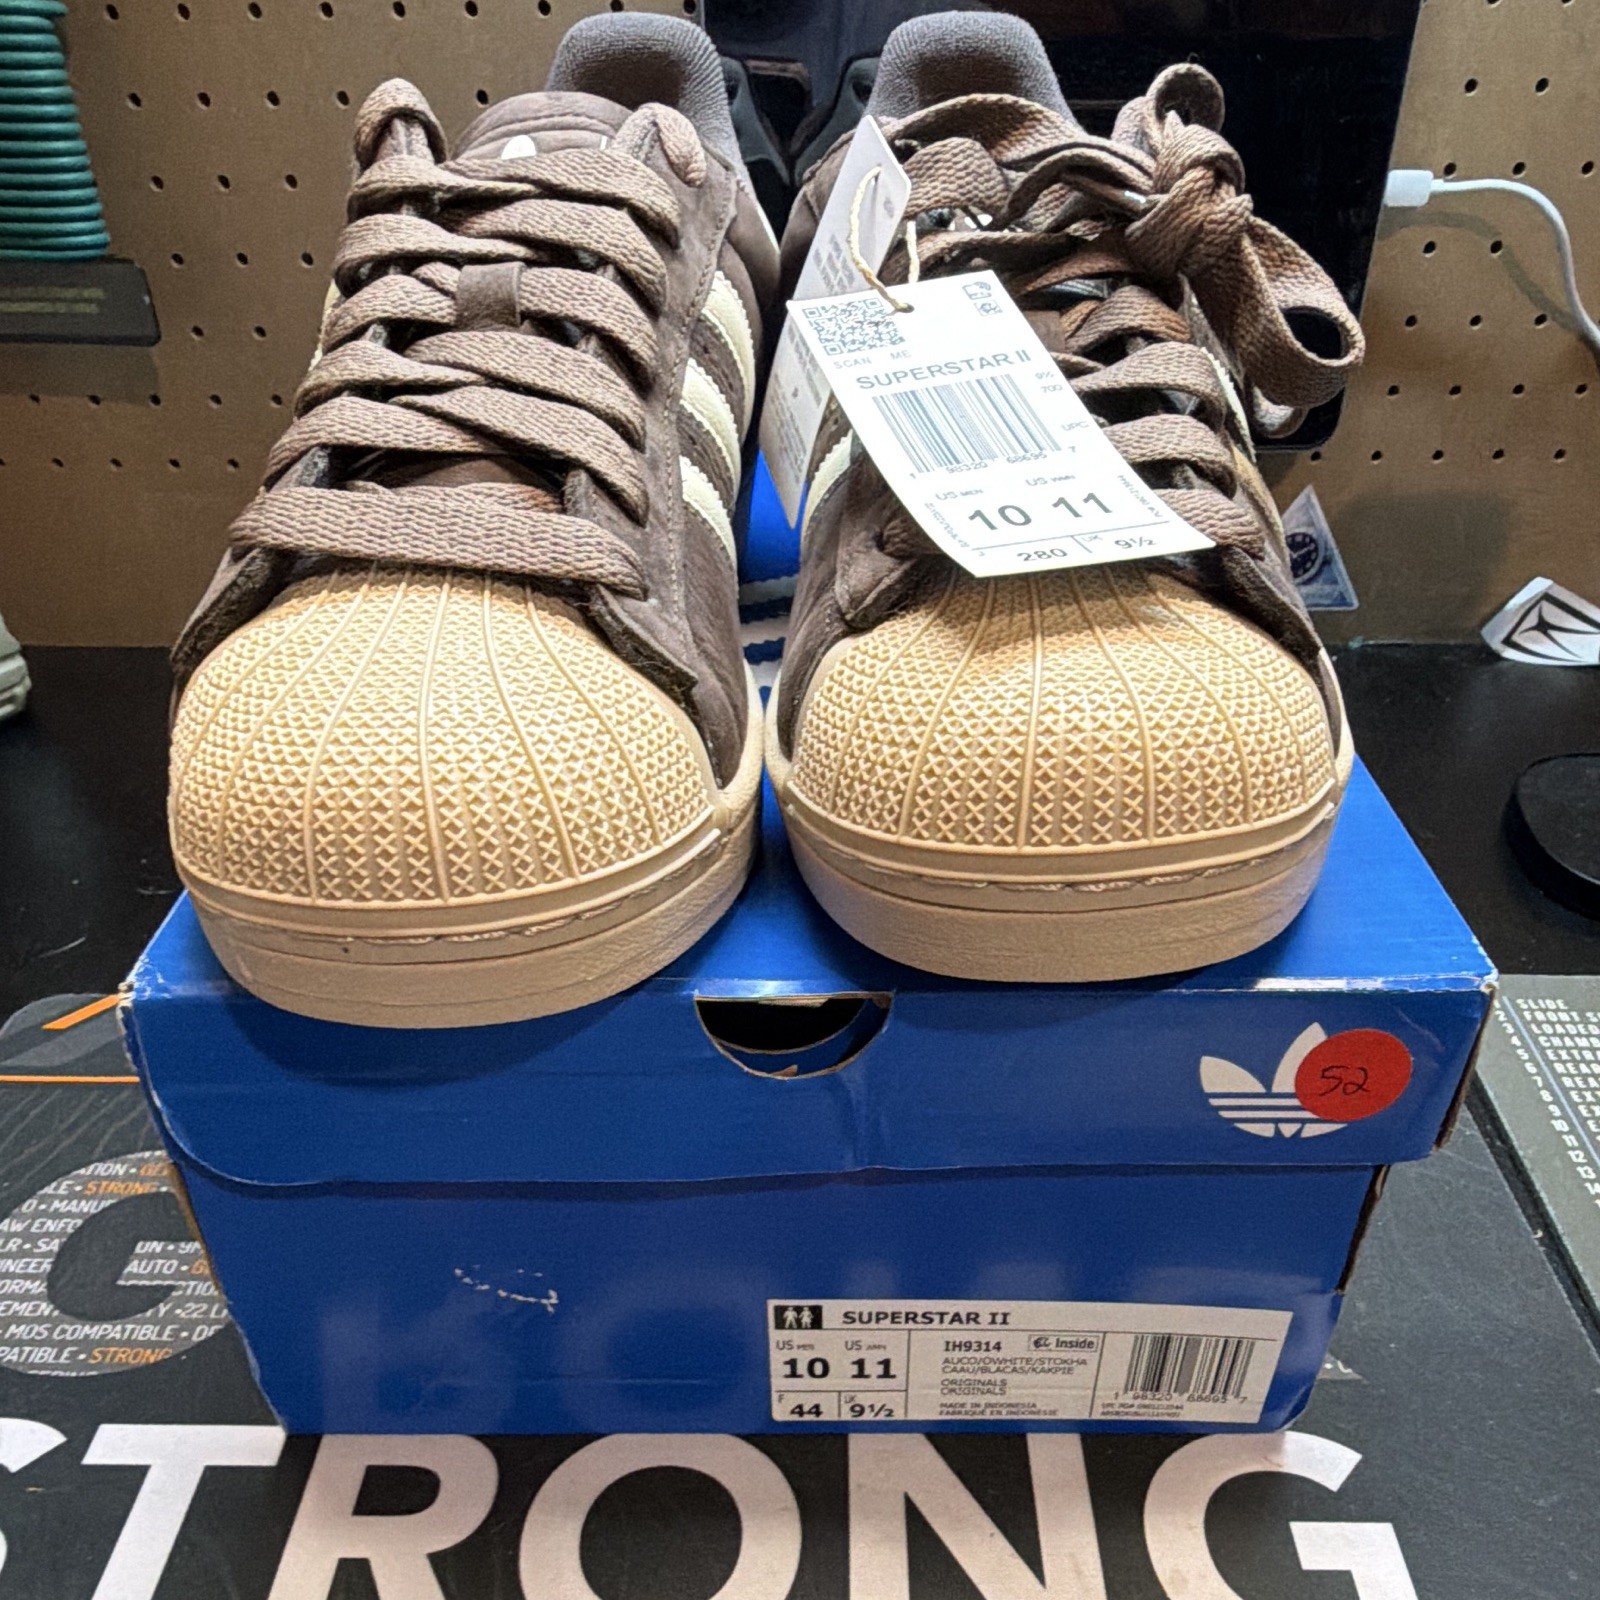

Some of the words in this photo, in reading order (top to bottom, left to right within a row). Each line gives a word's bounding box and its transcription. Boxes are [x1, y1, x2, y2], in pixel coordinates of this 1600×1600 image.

[833, 357, 872, 369] SCAN
[890, 349, 912, 360] ME
[856, 353, 1014, 390] SUPERSTAR
[1014, 349, 1032, 363] II
[1025, 476, 1048, 487] US
[935, 490, 958, 501] US
[968, 504, 1032, 531] 10
[1052, 492, 1113, 518] 11
[1017, 548, 1068, 562] 280
[1516, 998, 1569, 1010] SLIDE
[1495, 1010, 1508, 1021] 2
[1523, 1010, 1580, 1022] FRONT
[1502, 1022, 1515, 1034] 3
[1516, 1048, 1529, 1060] 5
[1524, 1062, 1538, 1074] 6
[1319, 1064, 1371, 1096] 52
[1532, 1075, 1544, 1088] 7
[1540, 1089, 1554, 1102] 8
[1548, 1104, 1562, 1117] 9
[1550, 1118, 1570, 1132] 10
[1561, 1134, 1579, 1147] 11
[1567, 1149, 1588, 1163] 12
[122, 1259, 179, 1275] AUTO
[842, 1311, 980, 1325] SUPERSTAR
[988, 1312, 1010, 1325] II
[4, 1323, 52, 1340] MOS
[52, 1324, 180, 1341] COMPATIBLE
[776, 1340, 794, 1350] US
[845, 1340, 862, 1350] US
[943, 1340, 1002, 1352] IH9314
[1055, 1337, 1095, 1349] Inside
[783, 1357, 830, 1379] 10
[851, 1358, 897, 1379] 11
[941, 1378, 1008, 1387] ORIGINALS
[940, 1387, 1007, 1396] ORIGINALS
[790, 1403, 823, 1417] 44
